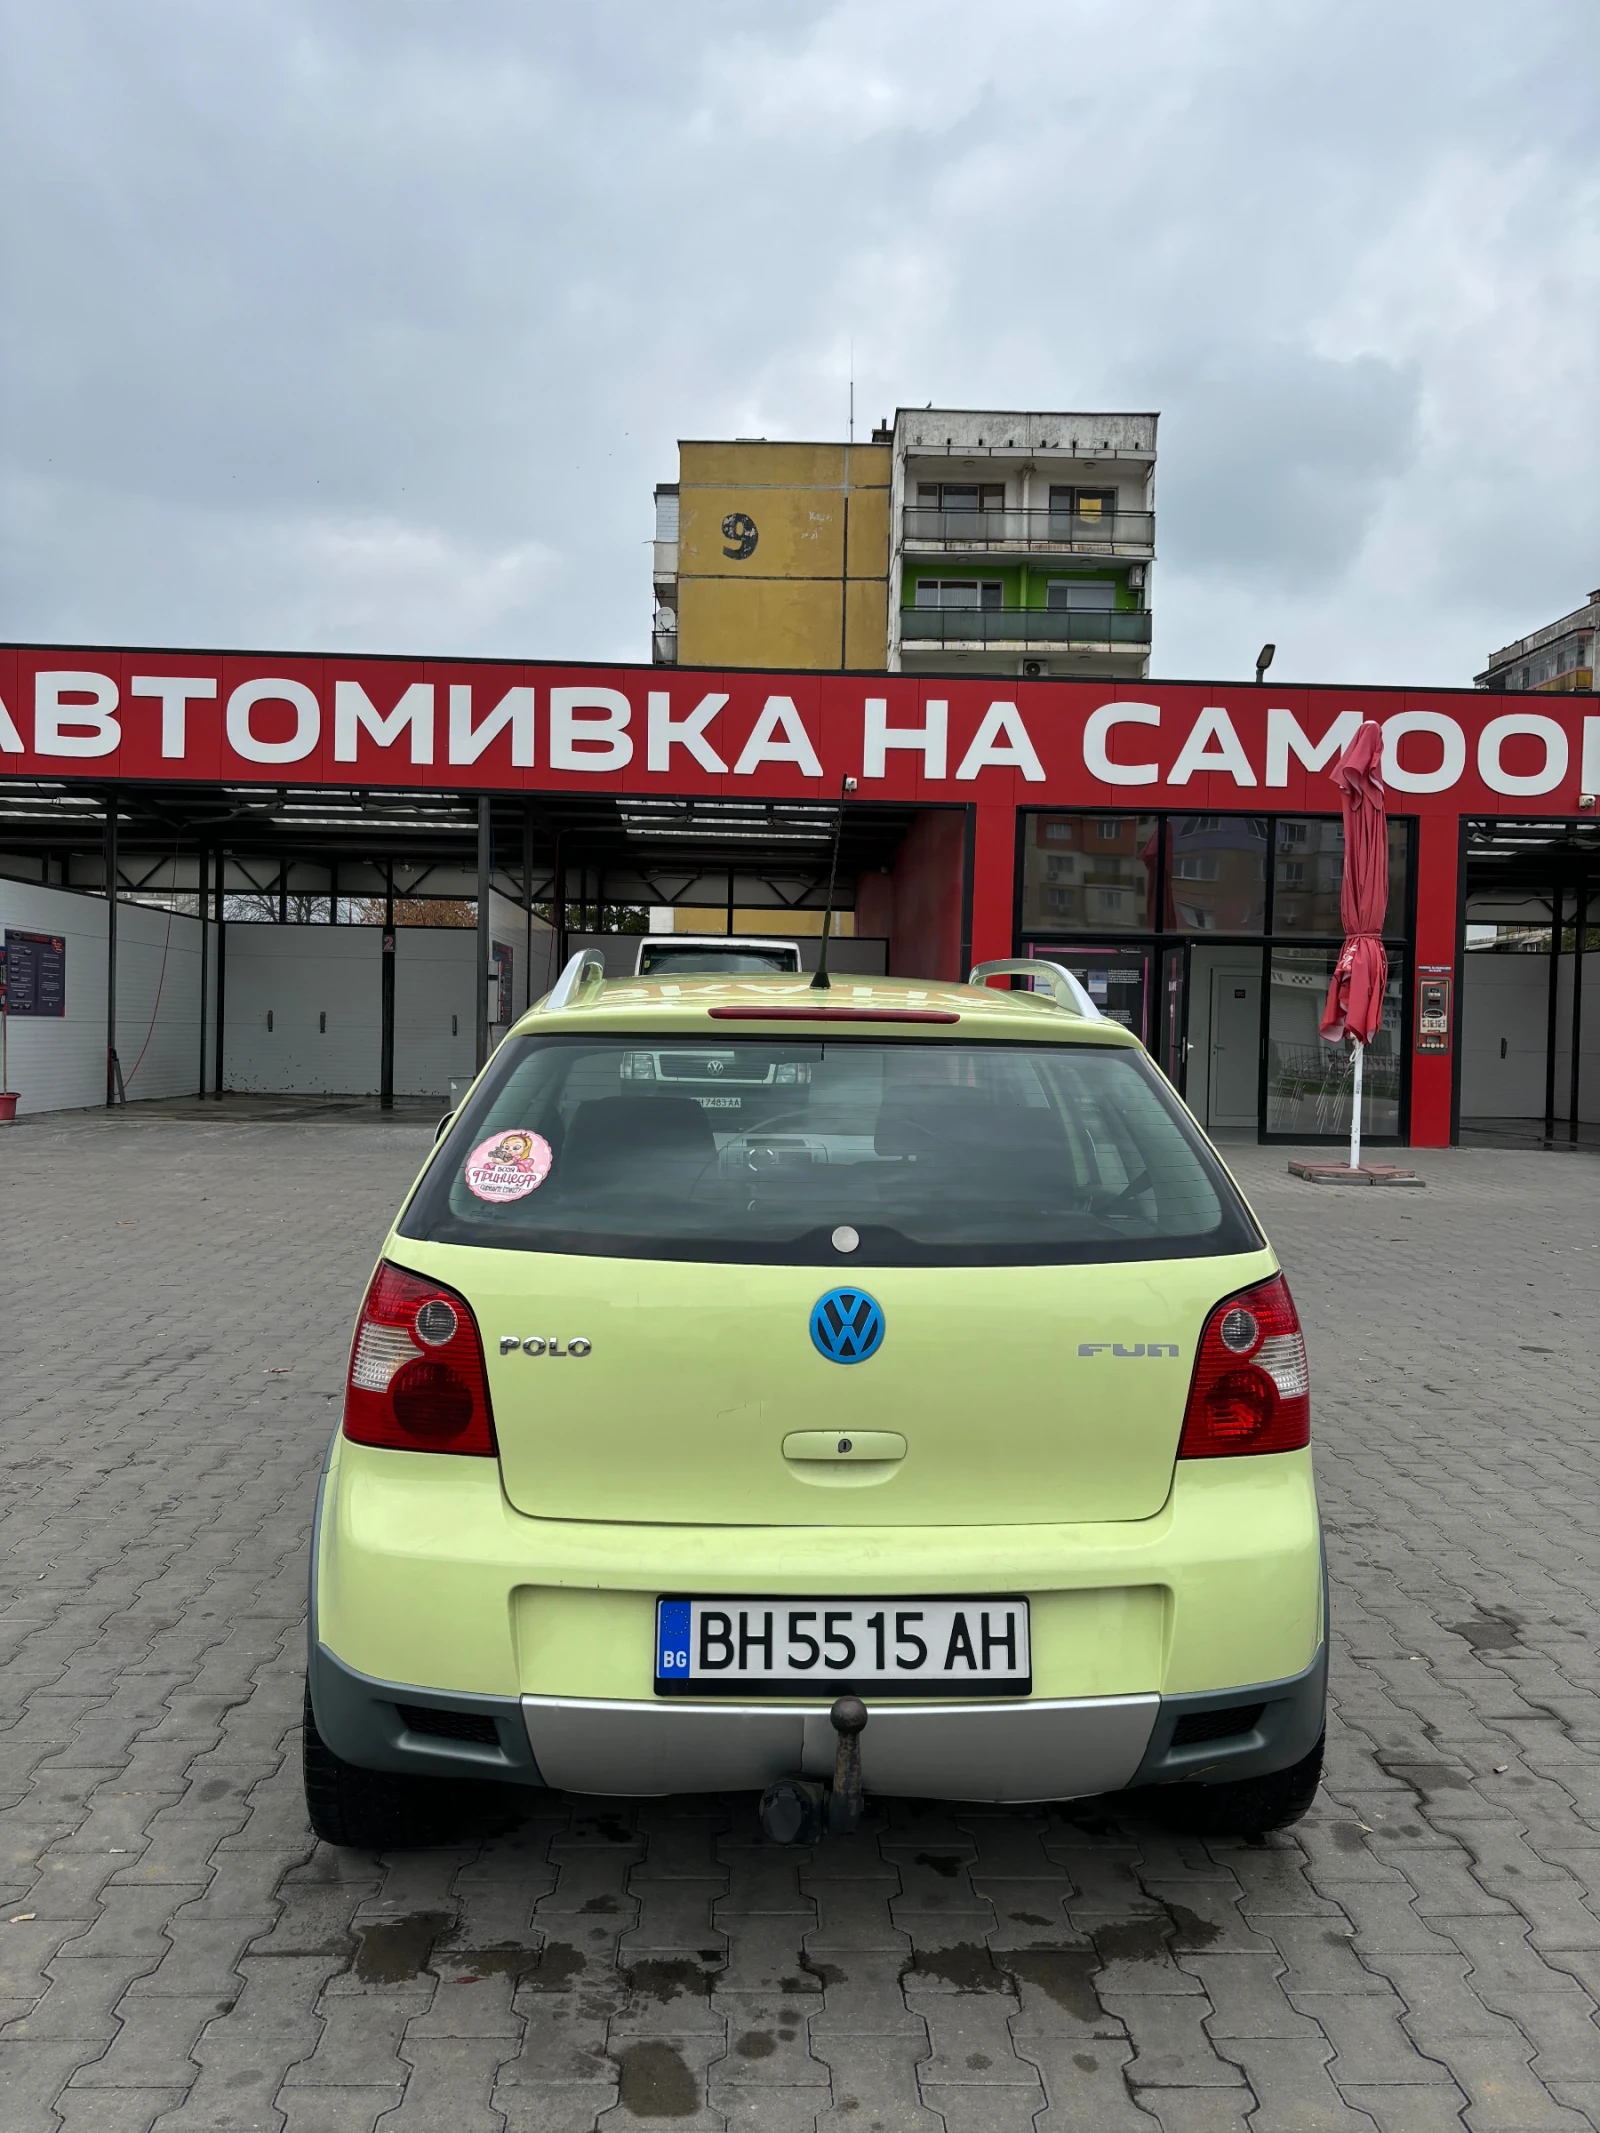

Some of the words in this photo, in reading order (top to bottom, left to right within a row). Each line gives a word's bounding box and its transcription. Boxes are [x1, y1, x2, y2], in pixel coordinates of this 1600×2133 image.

[721, 511, 759, 561] 9
[0, 670, 824, 778] ВТОМИВКА
[863, 697, 1046, 782] НА
[1082, 701, 1600, 797] САМОО
[500, 1335, 592, 1358] POLO
[663, 1650, 688, 1668] BG
[698, 1610, 773, 1671] BH
[787, 1611, 928, 1671] 5515
[943, 1611, 1017, 1671] AH
